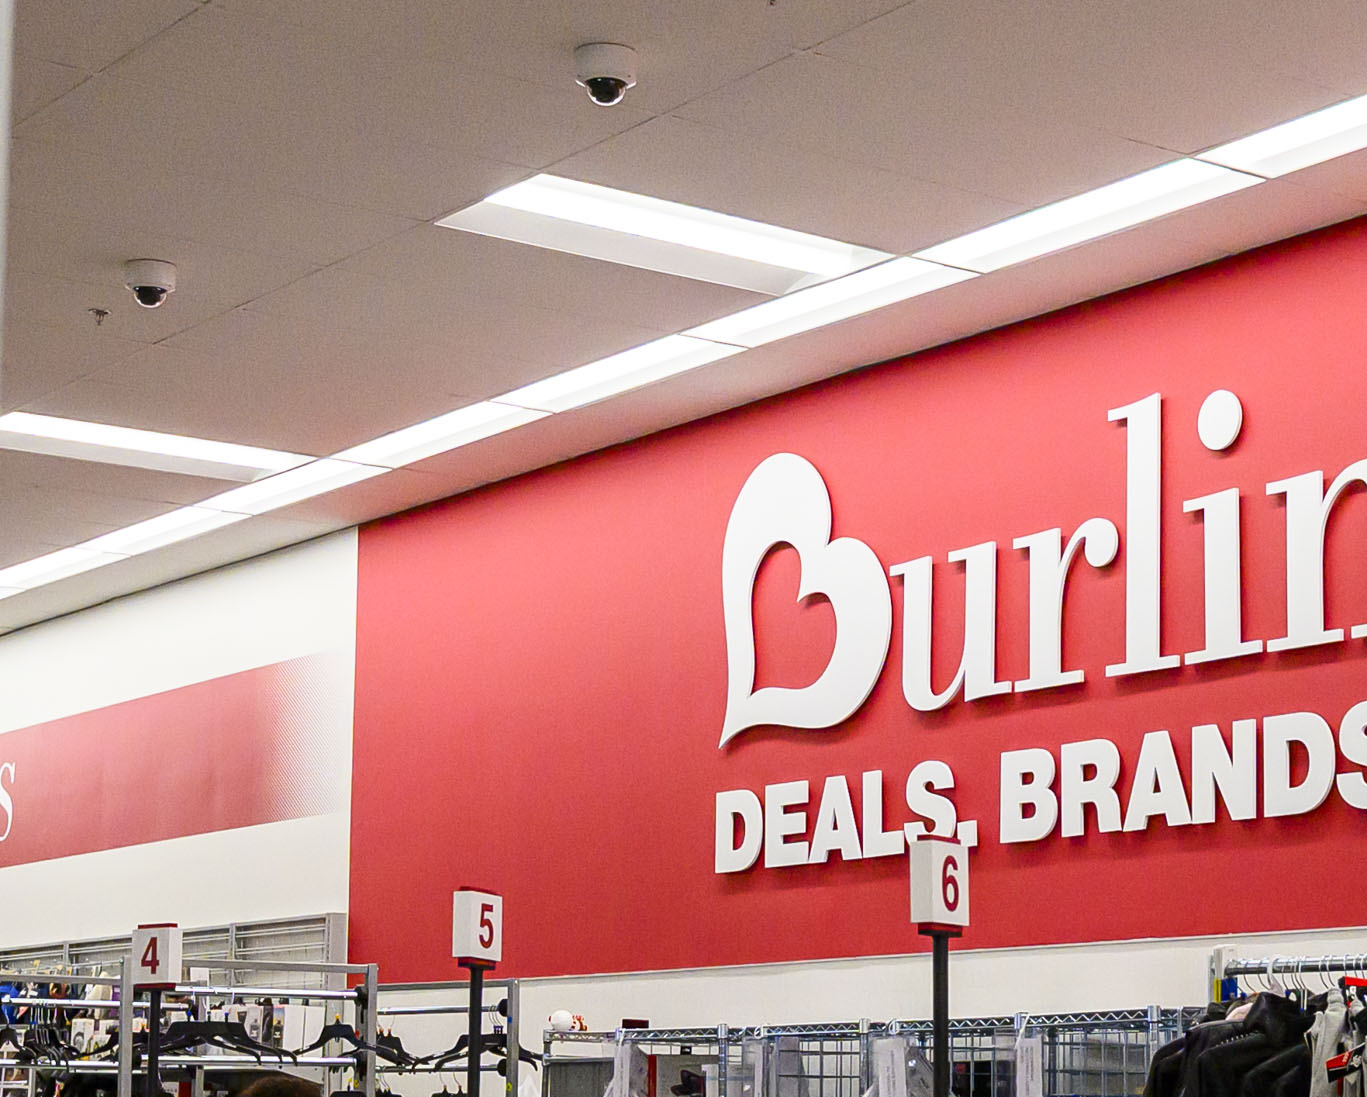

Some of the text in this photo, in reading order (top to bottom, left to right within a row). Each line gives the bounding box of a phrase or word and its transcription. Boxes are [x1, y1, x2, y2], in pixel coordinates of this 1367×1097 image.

[715, 760, 978, 874] DEALS.
[941, 855, 960, 912] 6
[479, 903, 495, 950] 5
[140, 936, 160, 974] 4
